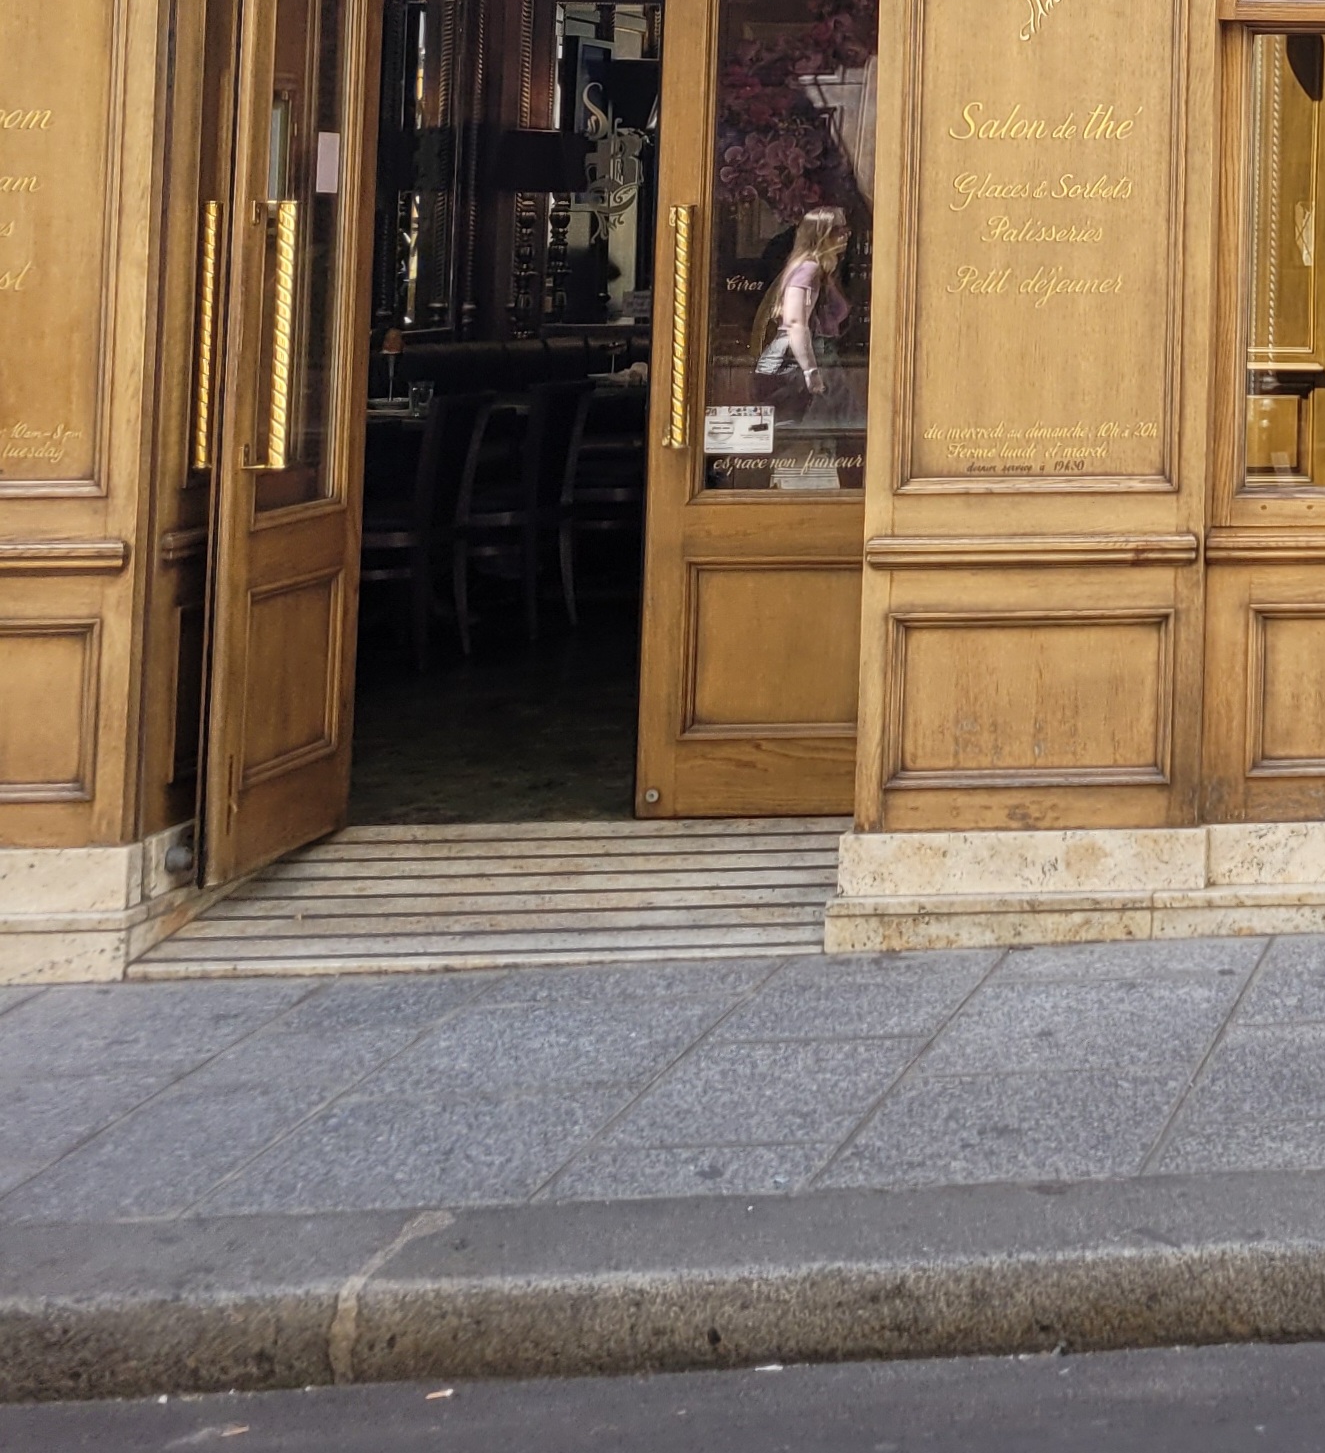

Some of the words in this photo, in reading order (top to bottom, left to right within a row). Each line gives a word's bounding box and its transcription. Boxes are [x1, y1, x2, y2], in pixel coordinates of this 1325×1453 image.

[949, 102, 1048, 139] Salon
[1052, 113, 1077, 139] de
[1083, 104, 1143, 139] thé
[950, 172, 1029, 211] Glaces
[1033, 180, 1047, 198] &
[1051, 174, 1133, 198] Sorbets
[947, 265, 1012, 294] Petit
[1019, 266, 1122, 308] déjeuner
[924, 424, 943, 440] du
[946, 421, 1003, 440] mercredi
[1007, 428, 1020, 439] au
[1096, 421, 1120, 439] 10h
[1133, 421, 1157, 439] 20h
[1000, 442, 1037, 458] lundi
[1045, 442, 1062, 458] et
[1063, 441, 1109, 458] mardi
[713, 456, 768, 476] espace
[770, 457, 796, 469] non
